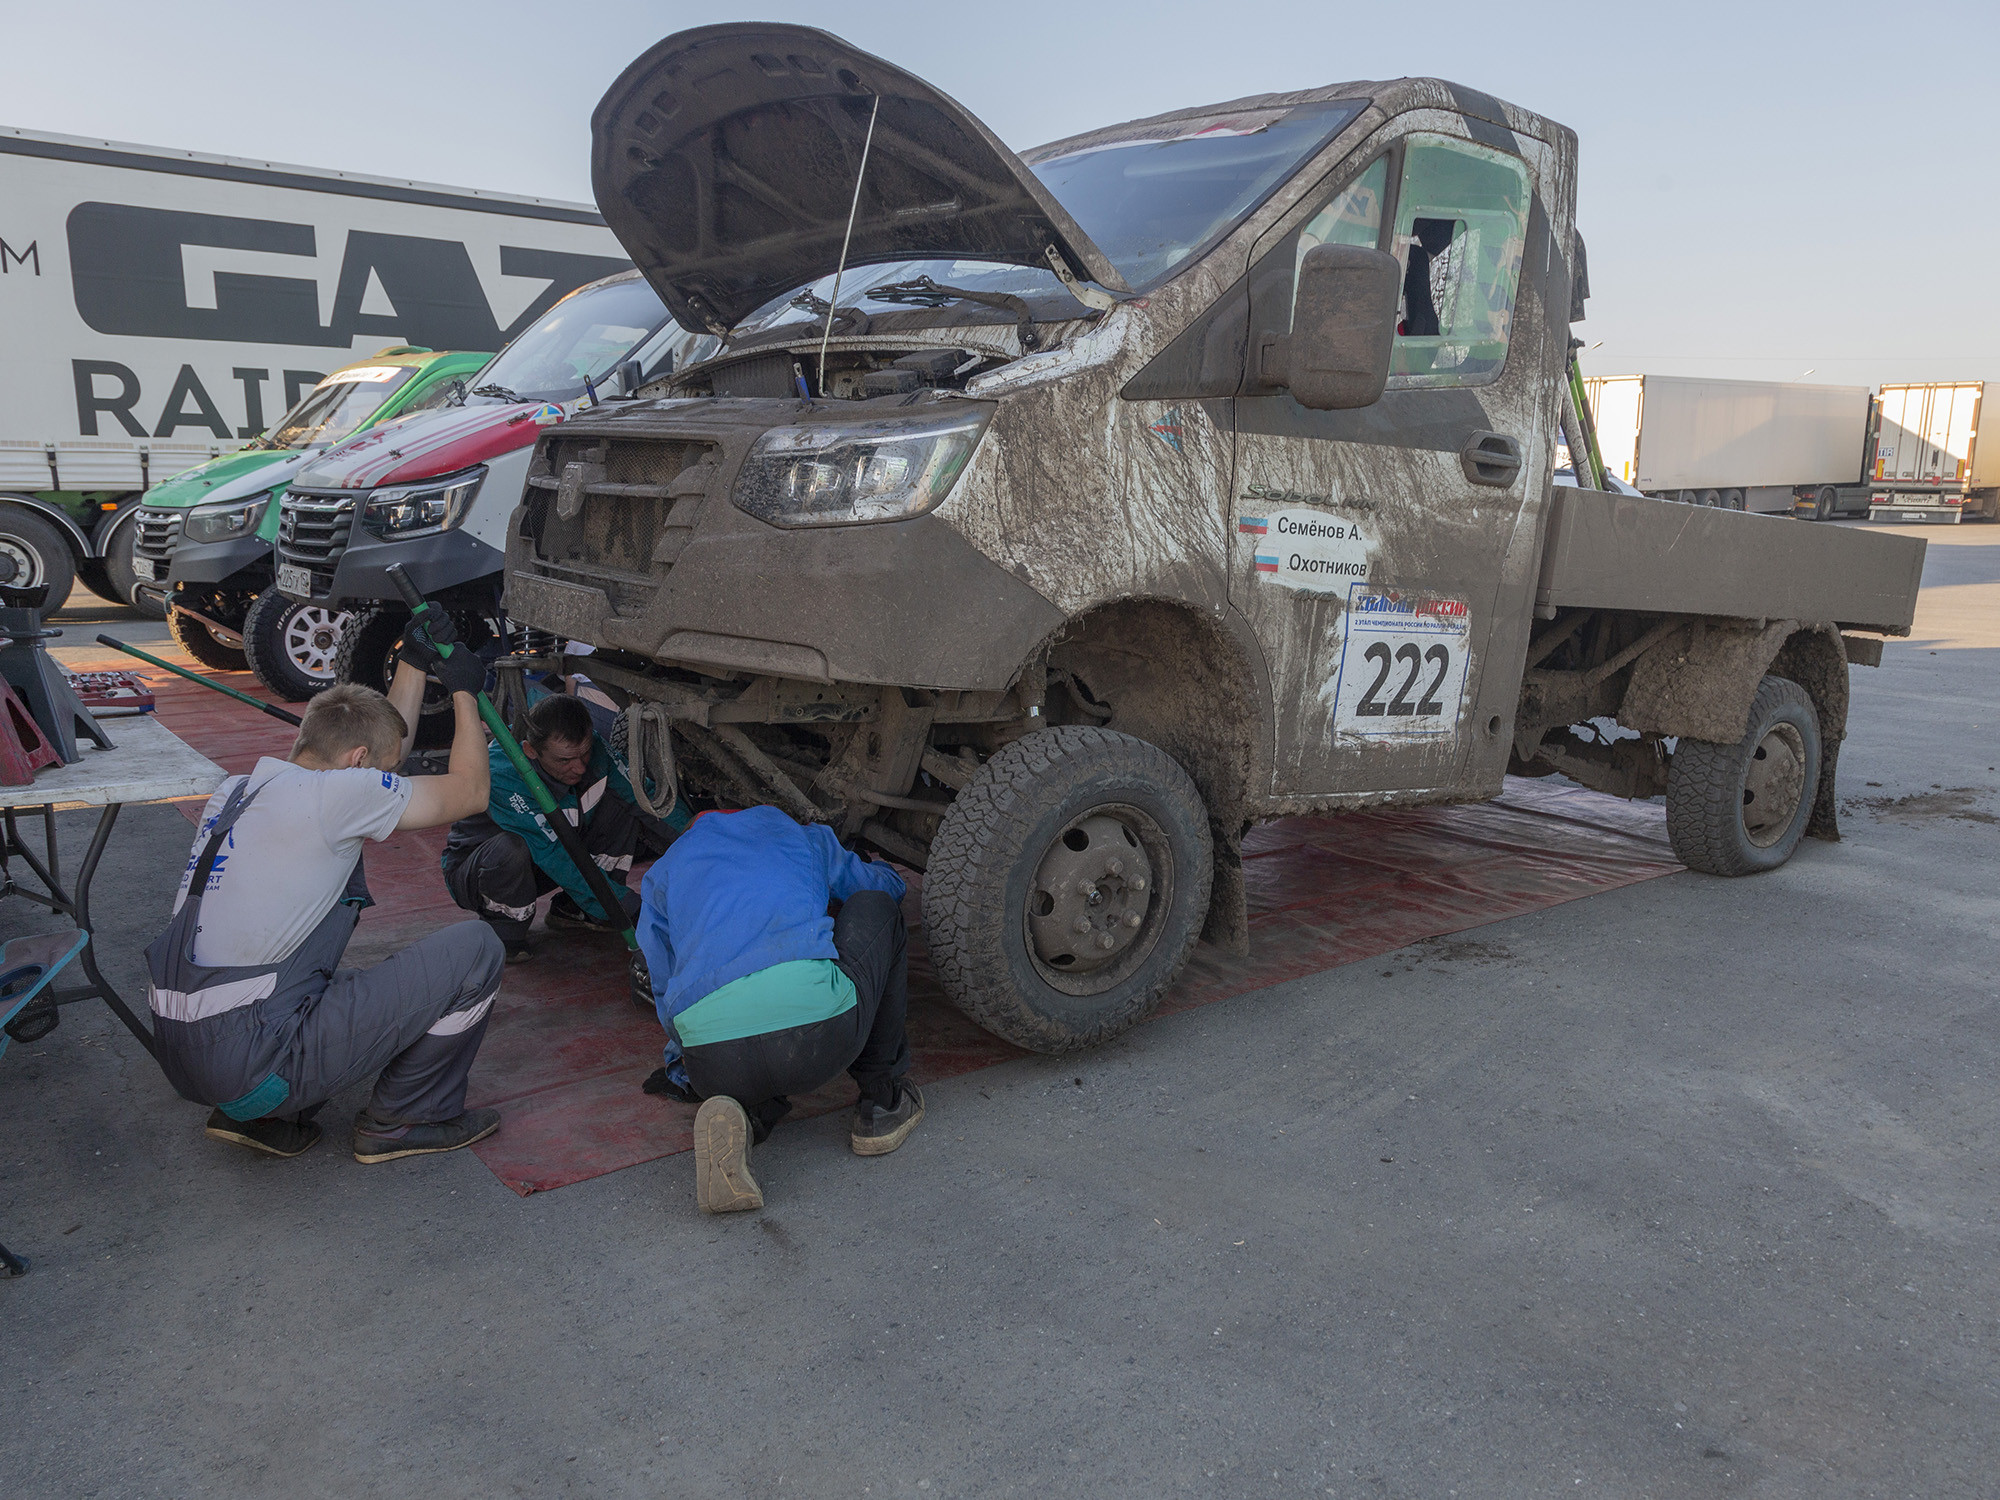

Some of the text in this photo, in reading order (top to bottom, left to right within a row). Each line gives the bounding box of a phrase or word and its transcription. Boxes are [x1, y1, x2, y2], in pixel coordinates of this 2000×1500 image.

[1277, 516, 1363, 541] Семёнов А.
[1289, 553, 1367, 577] Охотников
[1355, 641, 1450, 717] 222
